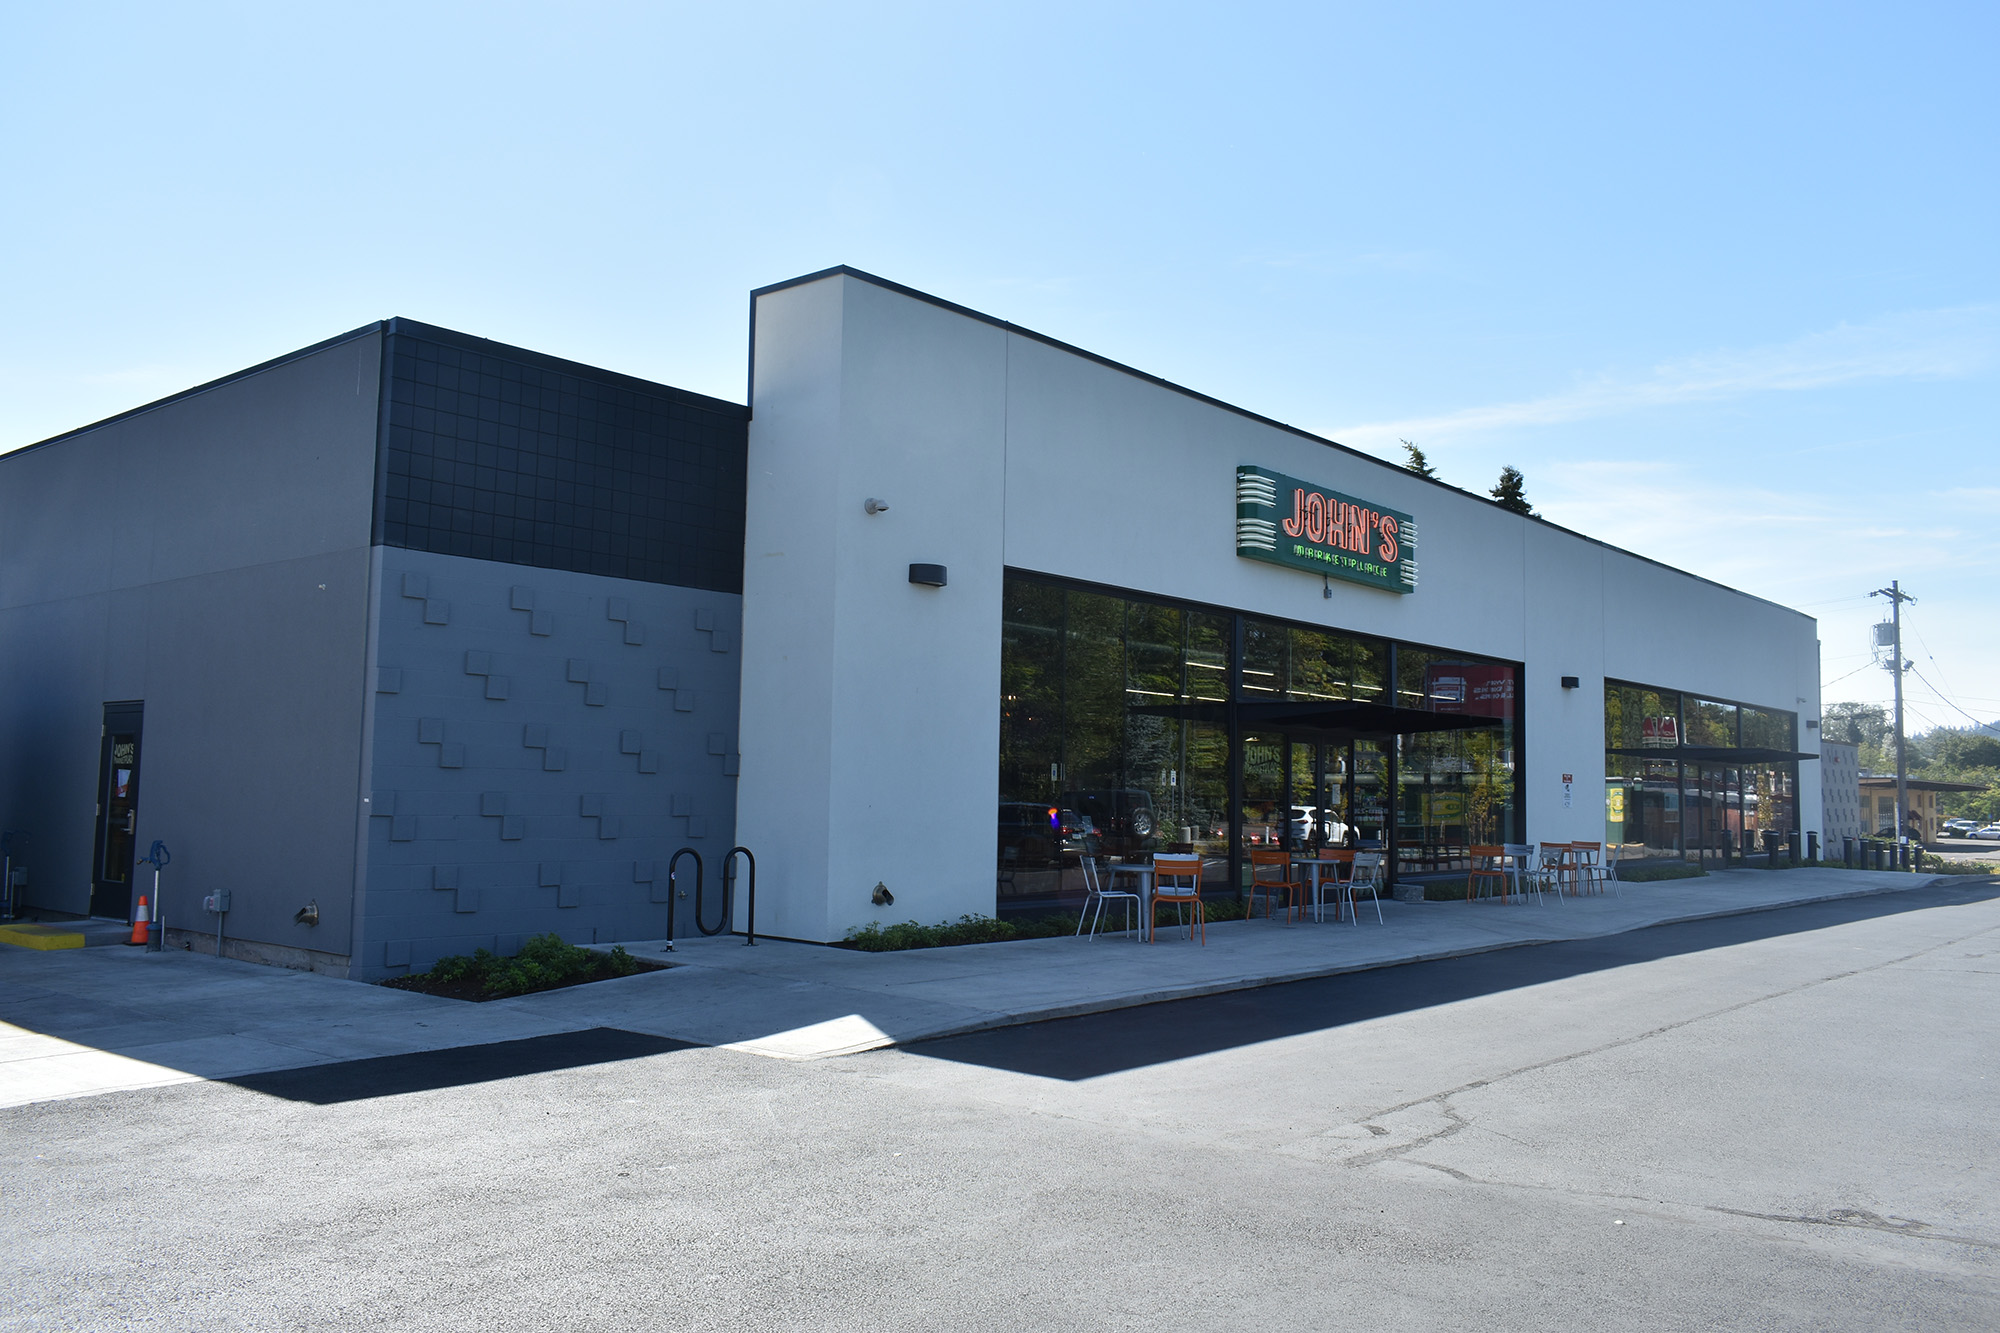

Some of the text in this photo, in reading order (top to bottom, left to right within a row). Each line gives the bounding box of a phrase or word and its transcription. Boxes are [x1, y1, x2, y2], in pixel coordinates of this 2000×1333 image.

[1283, 488, 1398, 563] JOHN'S
[1294, 544, 1387, 577] MARKETPLACE
[114, 742, 134, 757] JOHN'S
[1244, 745, 1281, 765] JOHN'S
